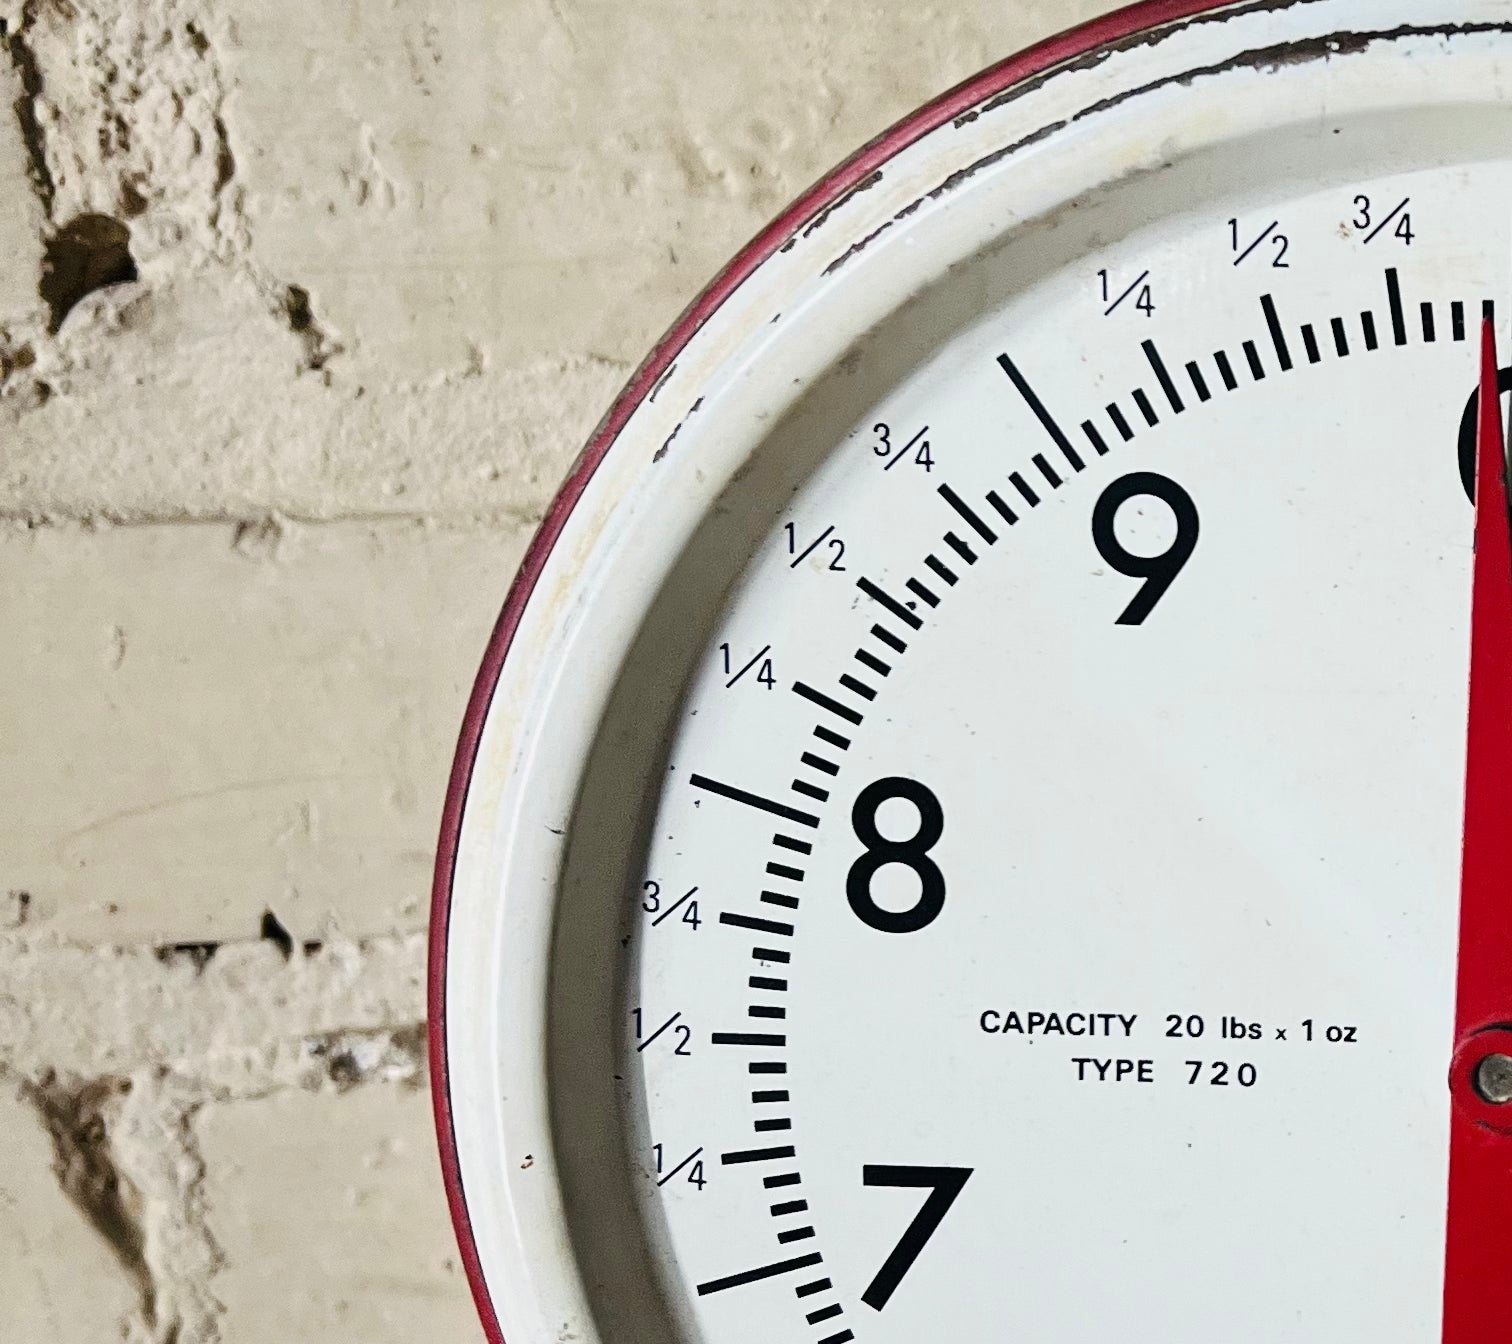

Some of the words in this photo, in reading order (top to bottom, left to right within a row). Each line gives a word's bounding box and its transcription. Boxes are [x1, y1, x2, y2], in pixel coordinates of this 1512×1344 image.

[1228, 218, 1289, 268] 1/2
[1353, 195, 1415, 246] 3/4
[1097, 269, 1155, 317] 1/4
[873, 423, 935, 472] 3/4
[784, 522, 846, 571] 1/2
[1092, 472, 1200, 625] 9
[719, 643, 776, 690] 1/4
[846, 777, 946, 933] 8
[643, 880, 701, 930] 3/4
[632, 1007, 691, 1056] 1/2
[980, 1010, 1137, 1037] CAPACITY
[1166, 1014, 1204, 1037] 20
[1222, 1016, 1262, 1039] lbs
[1275, 1029, 1287, 1040] x
[1302, 1019, 1312, 1041] 1
[1326, 1026, 1357, 1042] oz
[1071, 1058, 1154, 1082] TYPE
[1185, 1061, 1256, 1087] 720
[652, 1143, 707, 1190] 1/4
[861, 1165, 974, 1312] 7
